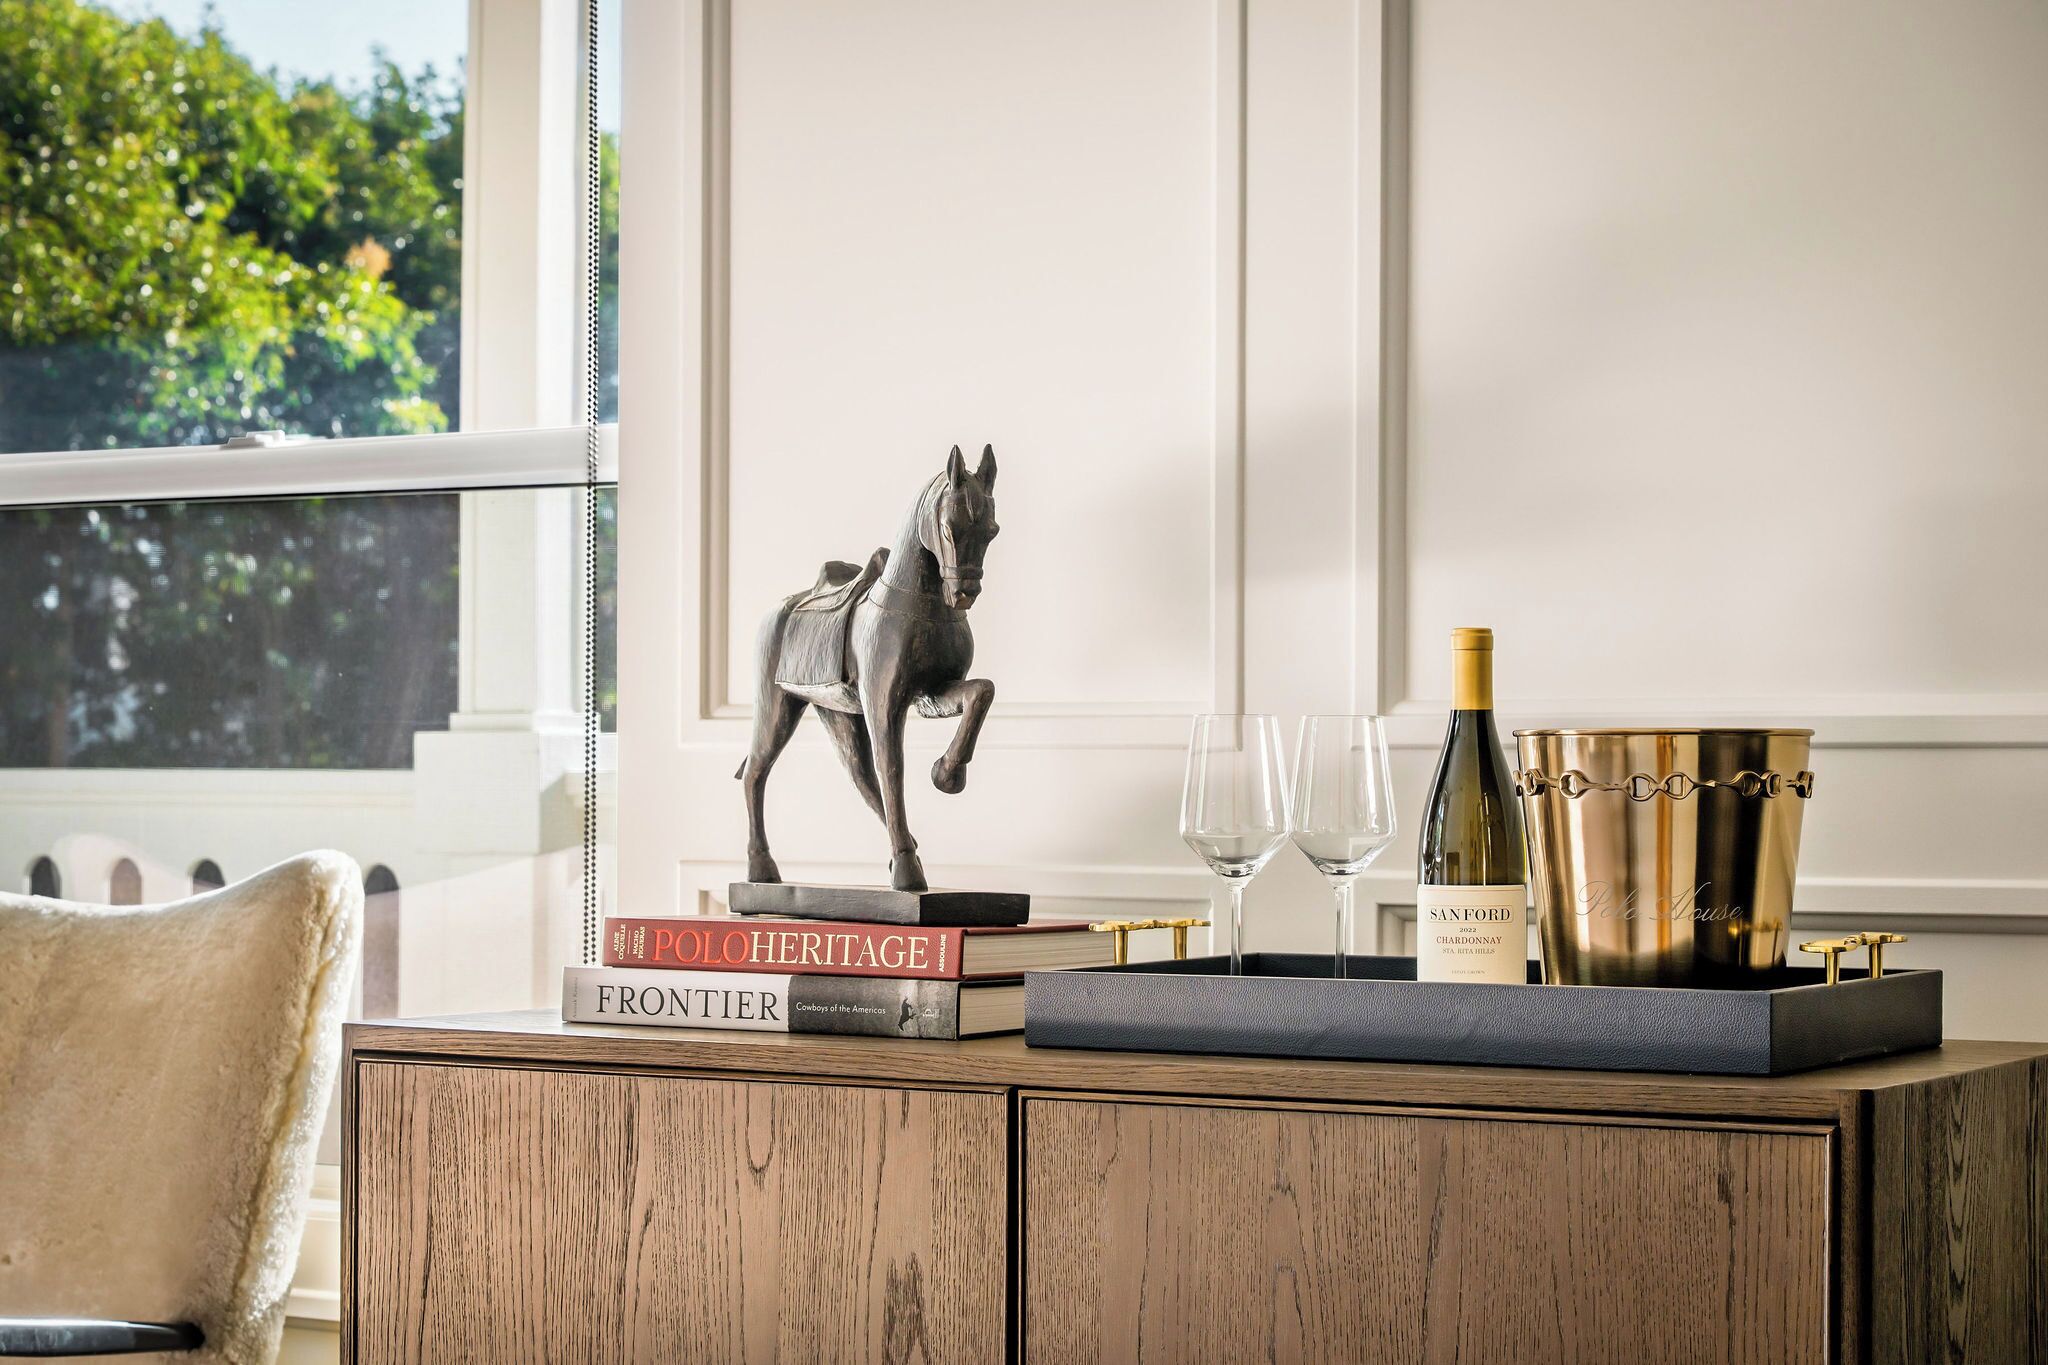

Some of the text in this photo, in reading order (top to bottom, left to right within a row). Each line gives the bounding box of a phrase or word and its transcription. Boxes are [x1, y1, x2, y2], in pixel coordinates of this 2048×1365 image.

[1576, 881, 1743, 921] Polo House
[1430, 908, 1510, 921] SANFORD
[1436, 935, 1503, 945] CHARDONNAY
[938, 933, 947, 973] ASSOULINE
[596, 984, 781, 1021] FRONTIER
[796, 1001, 887, 1015] Cowboys of the Americas
